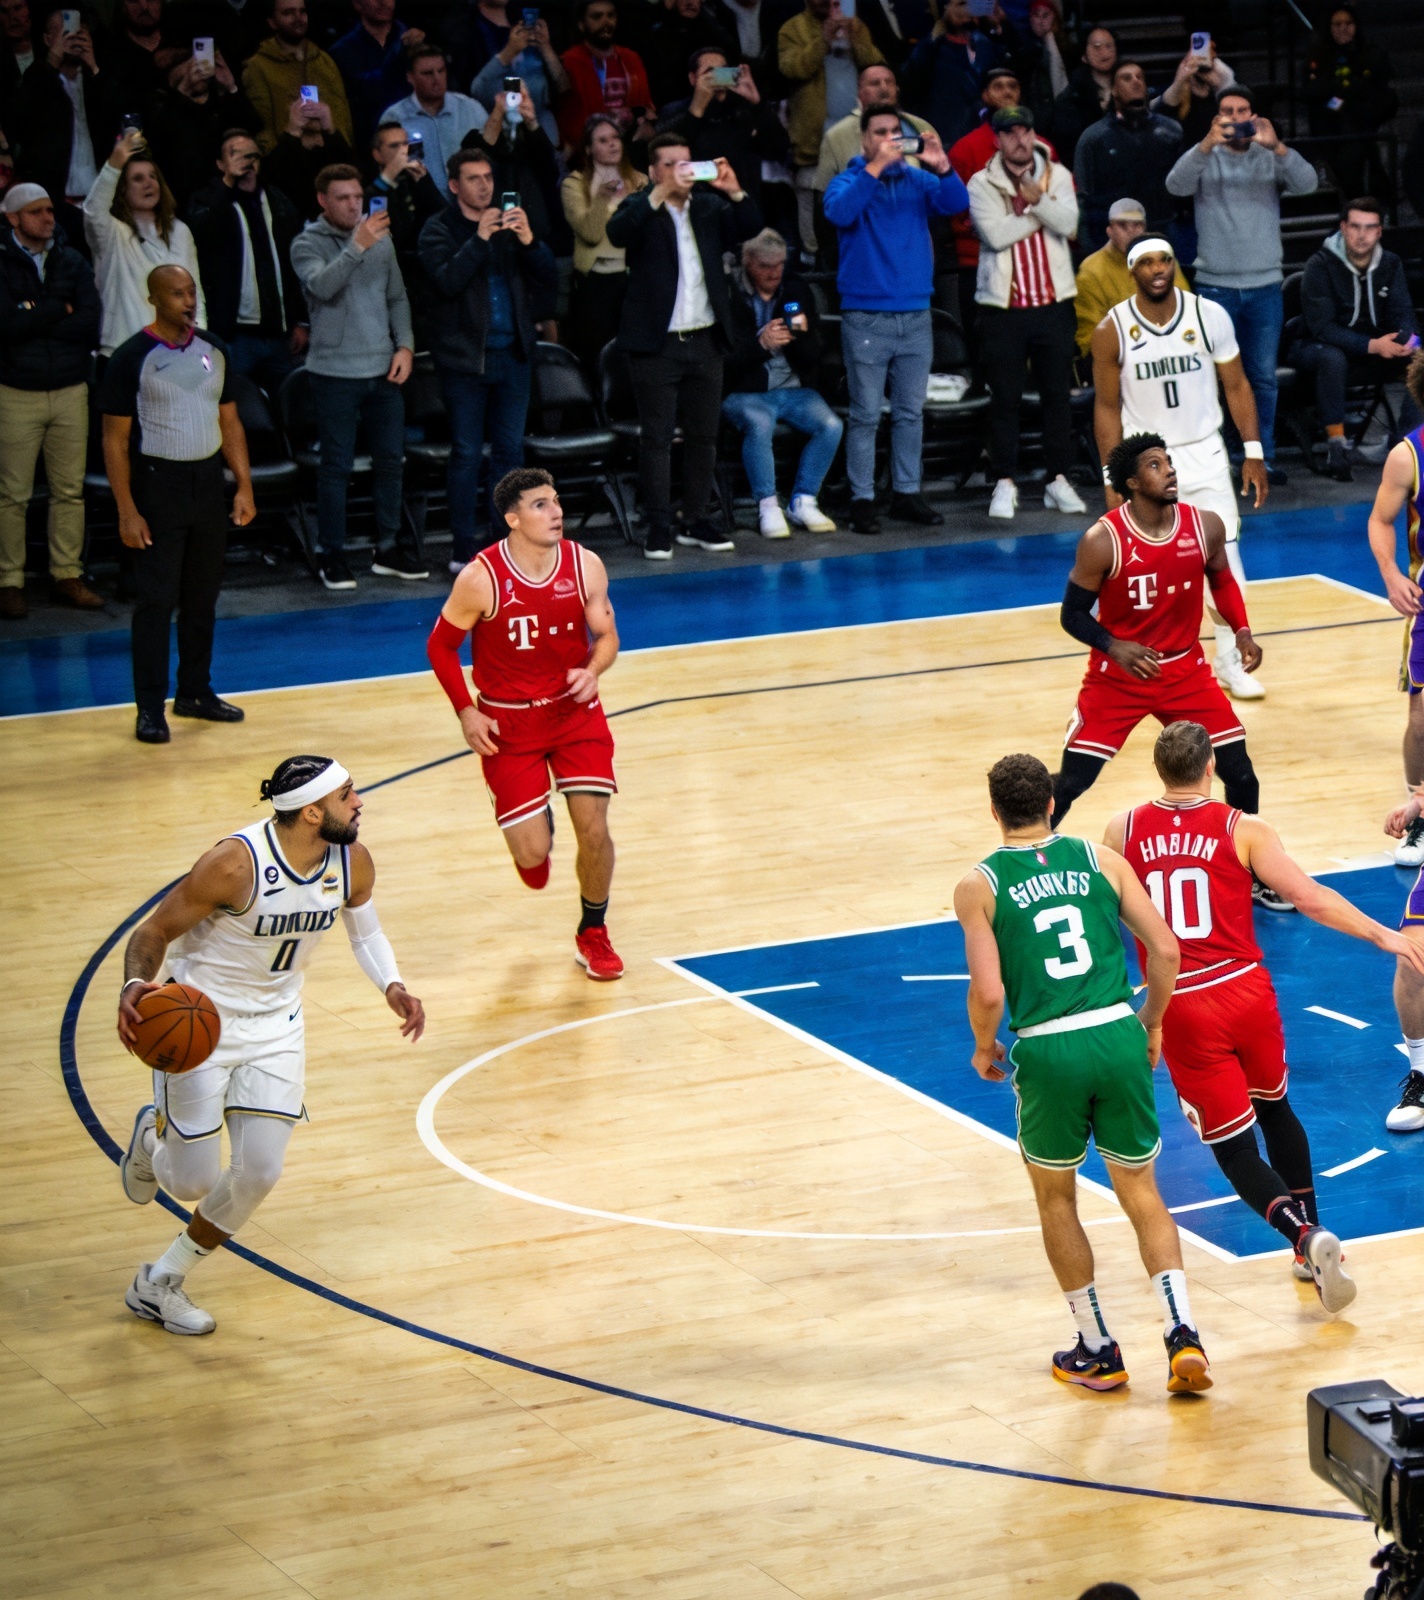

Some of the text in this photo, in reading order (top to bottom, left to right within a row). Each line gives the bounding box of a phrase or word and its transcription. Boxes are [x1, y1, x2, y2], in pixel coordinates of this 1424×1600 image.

[1163, 380, 1180, 409] 0
[1145, 867, 1213, 940] 10
[1033, 904, 1093, 980] 3
